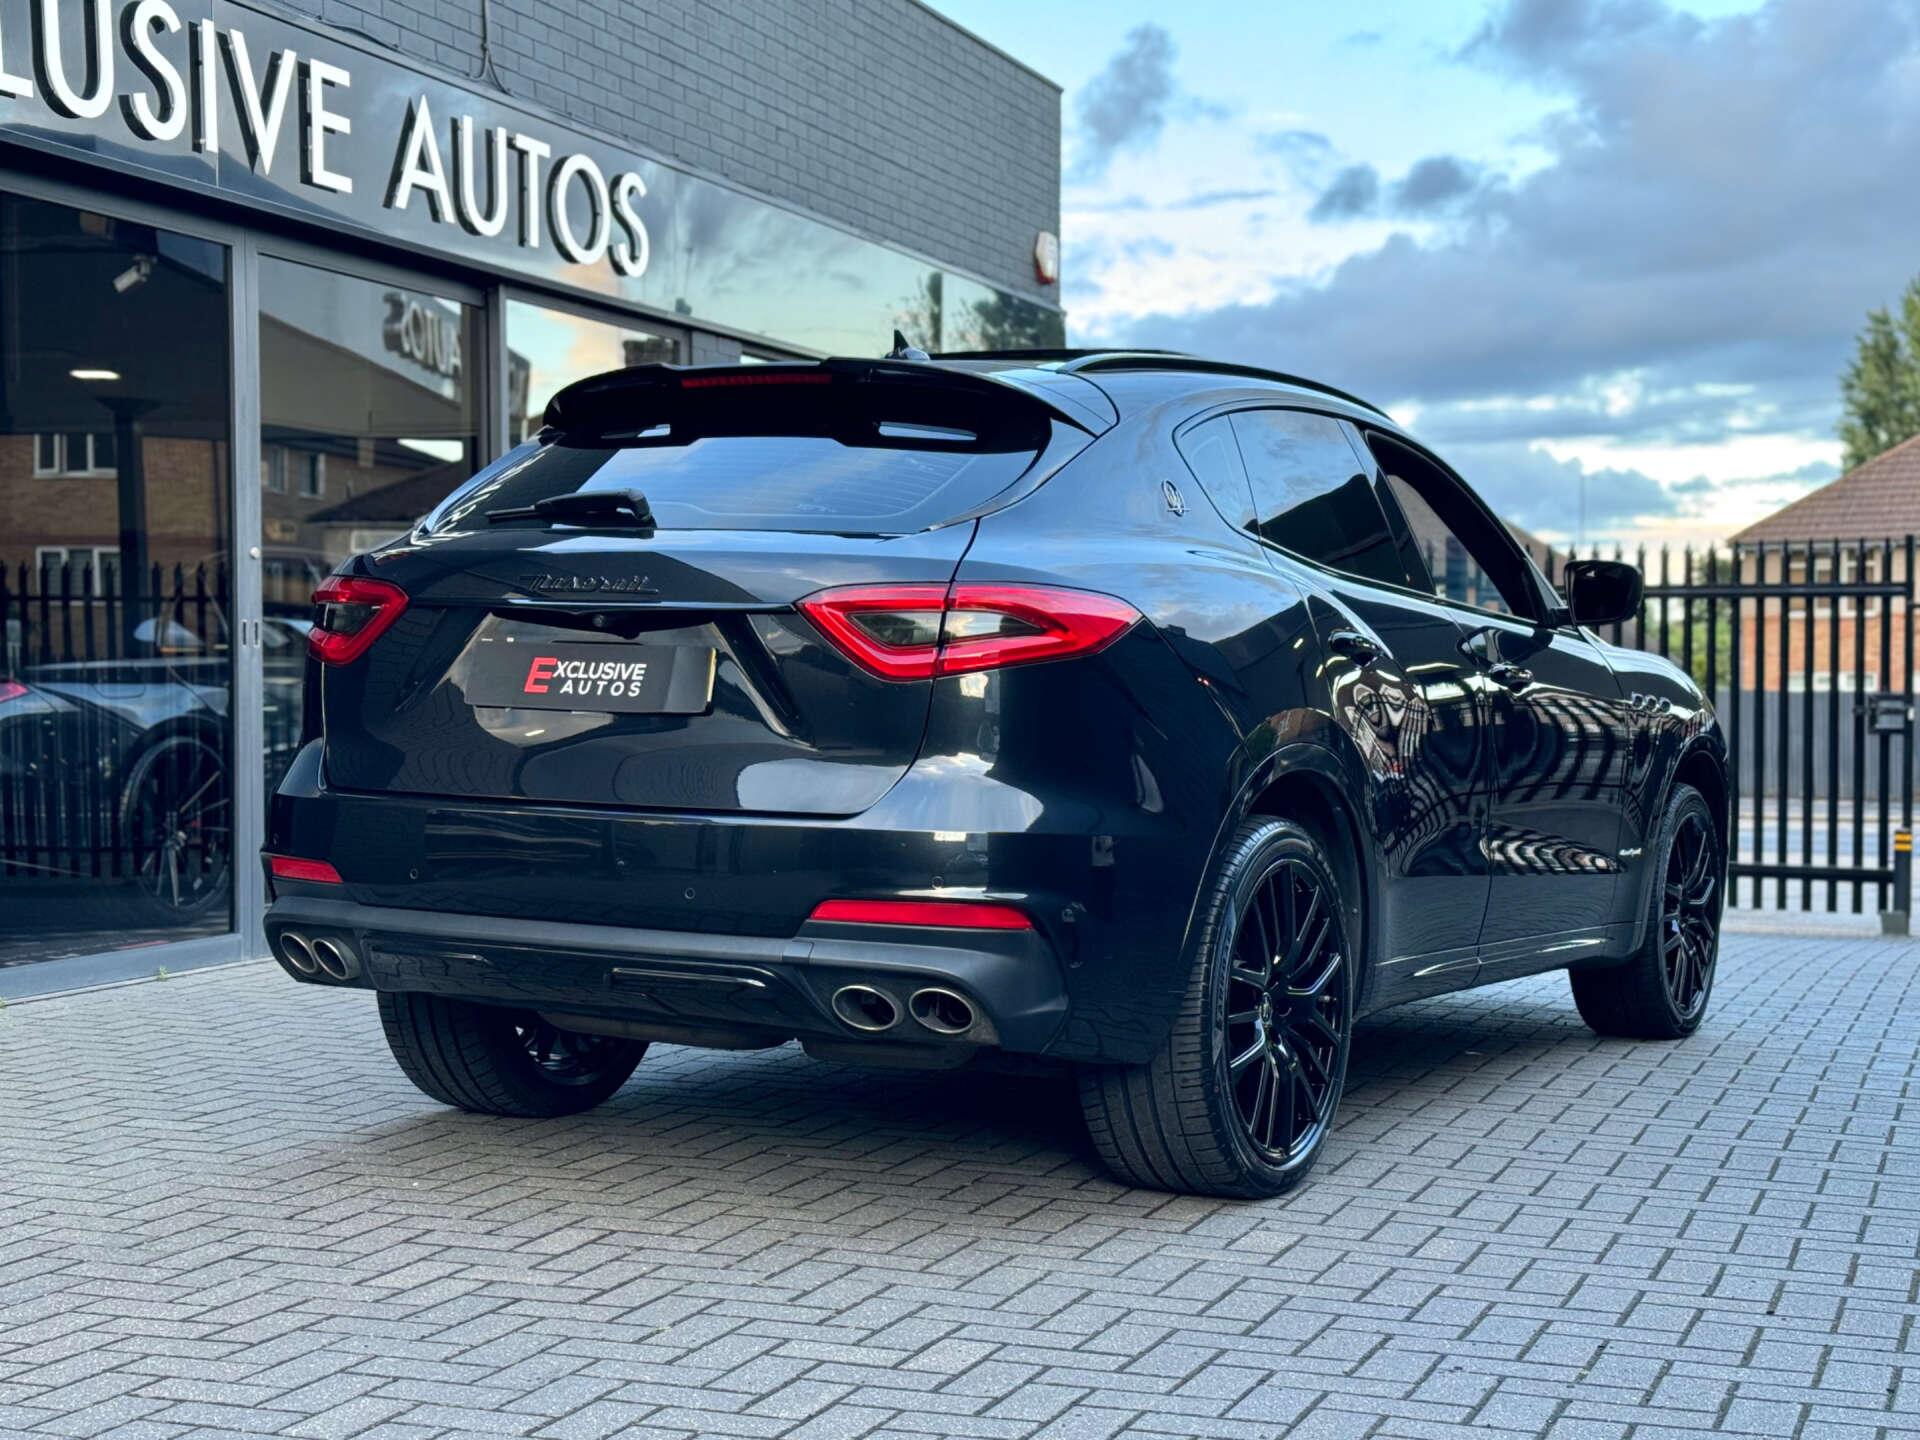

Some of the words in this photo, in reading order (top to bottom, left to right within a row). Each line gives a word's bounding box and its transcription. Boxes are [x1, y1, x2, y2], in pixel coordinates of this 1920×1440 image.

[395, 94, 649, 278] AUTOS
[523, 656, 647, 694] EXCLUSIVE
[560, 679, 641, 697] AUTOS
